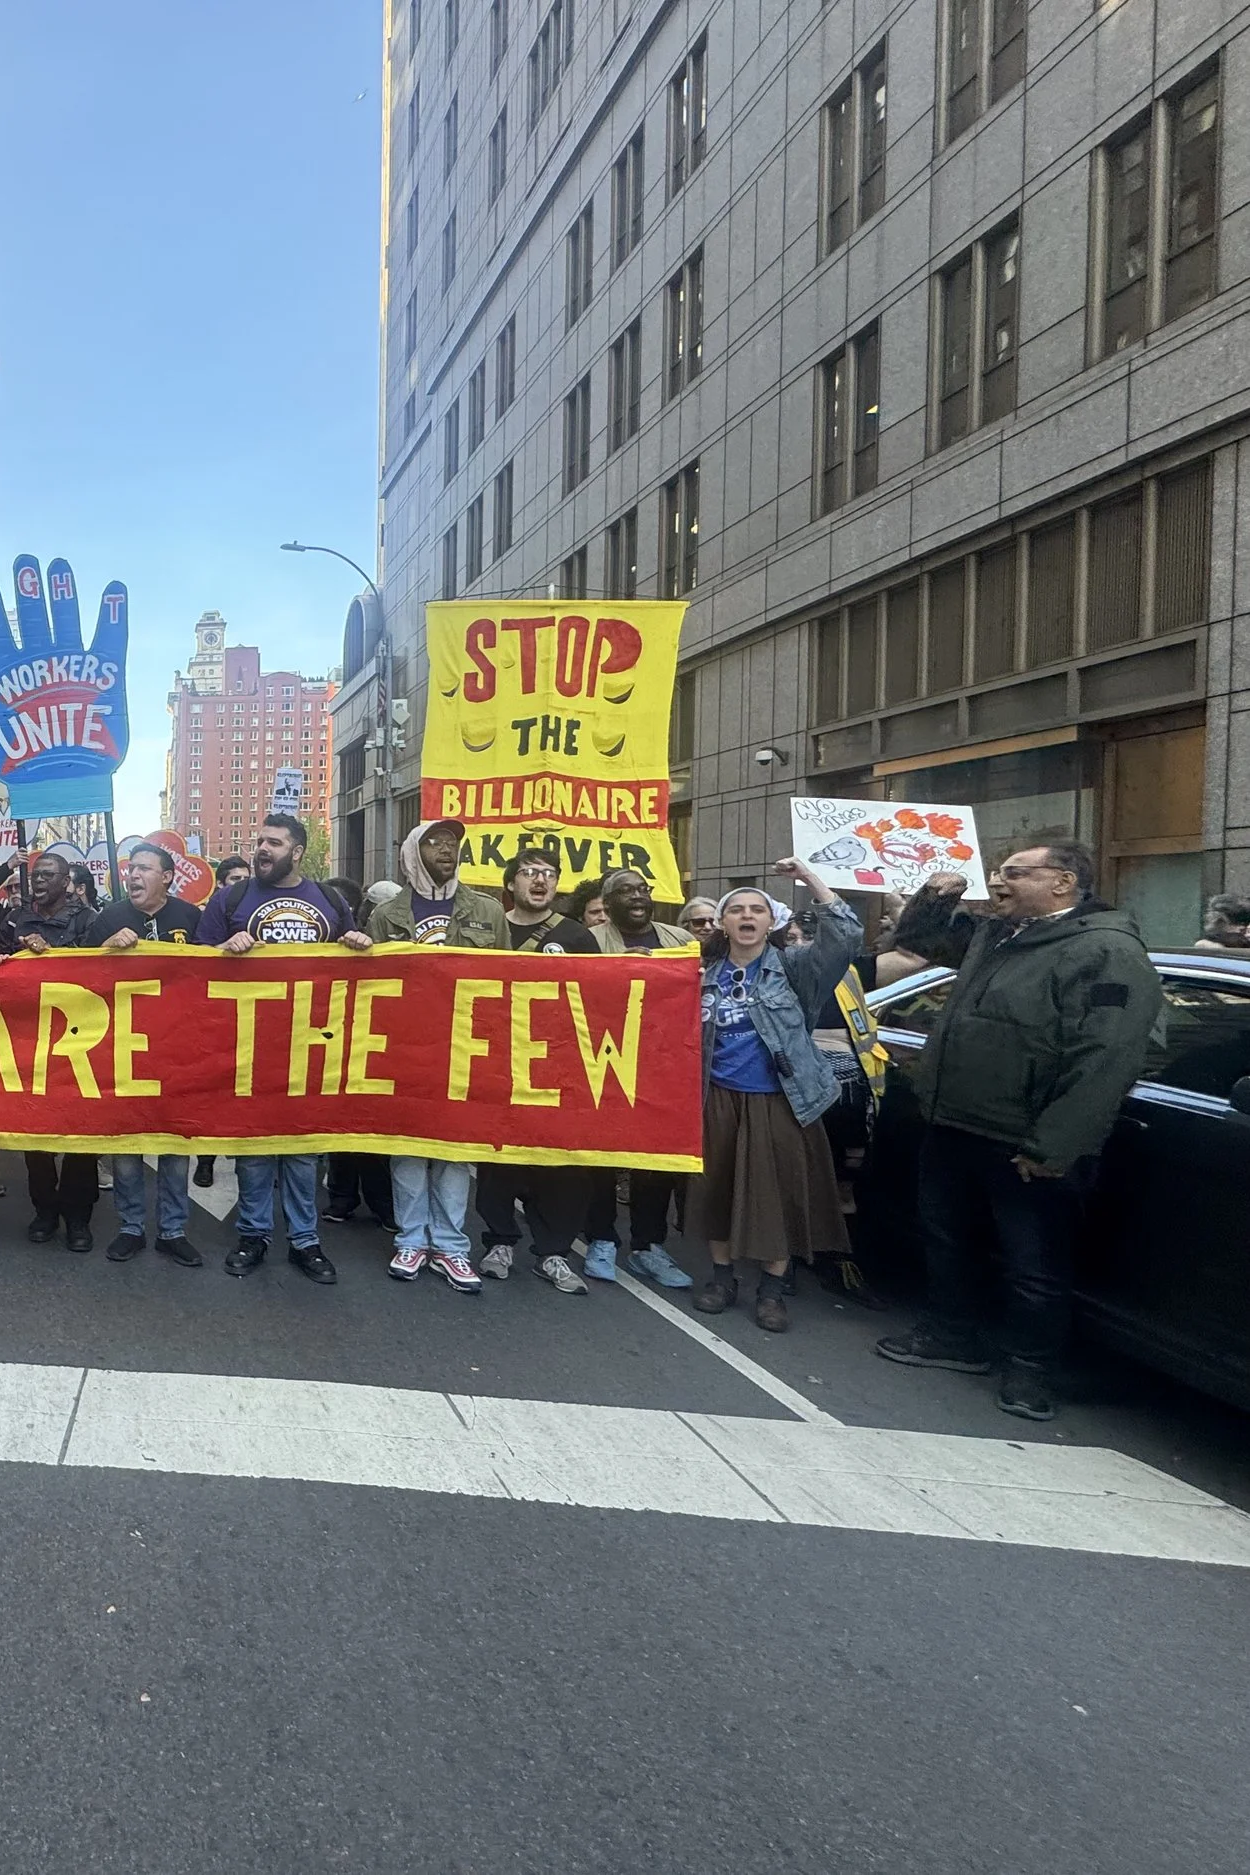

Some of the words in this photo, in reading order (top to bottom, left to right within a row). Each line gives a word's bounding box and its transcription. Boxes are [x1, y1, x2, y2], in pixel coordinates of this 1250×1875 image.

[463, 615, 643, 704] STOP
[511, 715, 581, 757] THE
[441, 776, 659, 825] BILLIONAIRE
[795, 799, 837, 821] NO
[811, 808, 867, 833] KINGS
[277, 901, 320, 920] POLITICAL
[262, 929, 317, 941] POWER
[208, 980, 402, 1097] THE
[448, 979, 648, 1110] FEW
